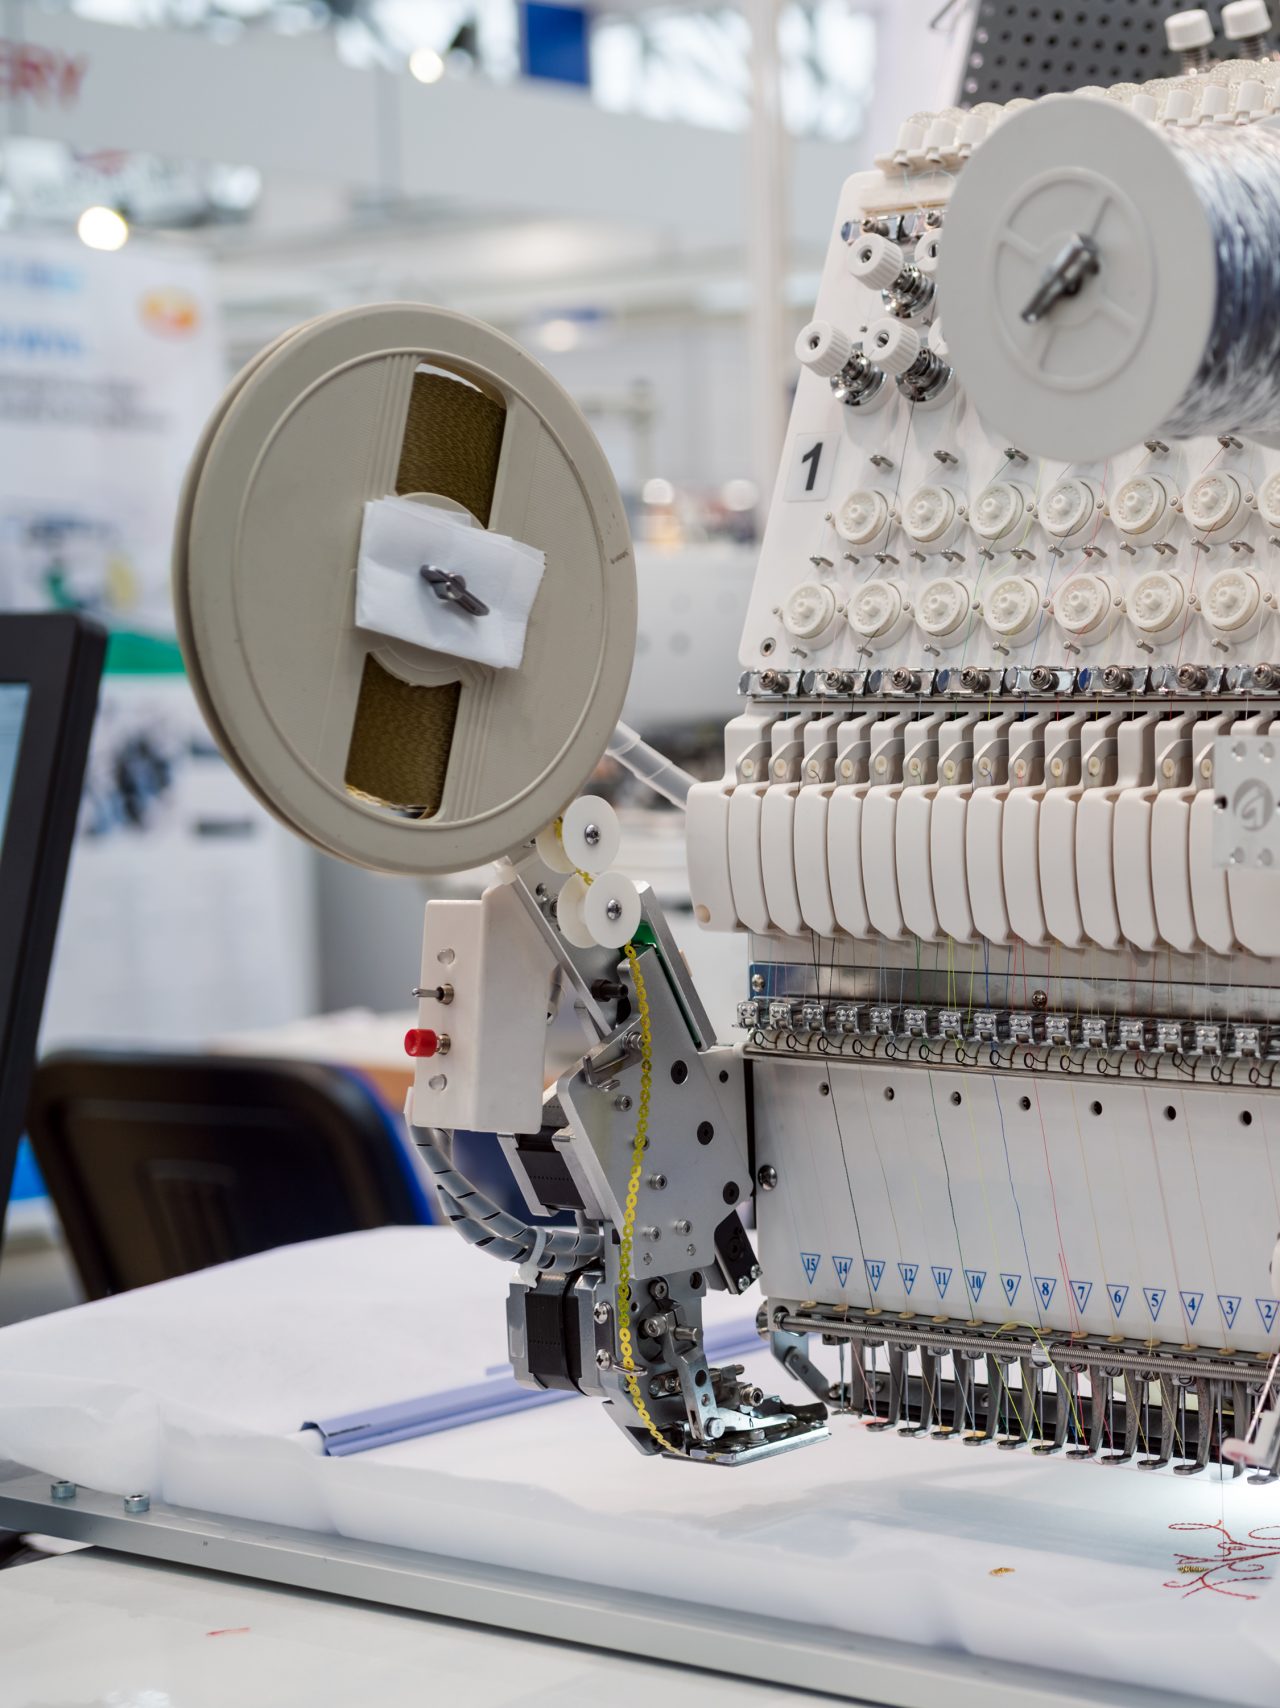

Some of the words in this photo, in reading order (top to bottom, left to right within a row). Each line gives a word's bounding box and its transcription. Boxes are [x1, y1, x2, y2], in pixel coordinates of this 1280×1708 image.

[802, 442, 823, 491] 1
[806, 1258, 816, 1271] 15
[838, 1261, 848, 1274] 14
[871, 1265, 880, 1278] 13
[904, 1268, 913, 1281] 12
[937, 1272, 946, 1285] 11
[971, 1275, 982, 1289] 10
[1006, 1279, 1014, 1292] 9
[1041, 1282, 1050, 1296] 8
[1077, 1286, 1085, 1299] 7
[1114, 1289, 1122, 1303] 6
[1151, 1293, 1159, 1307] 5
[1188, 1296, 1196, 1311] 4
[1226, 1301, 1234, 1315] 3
[1264, 1304, 1272, 1318] 2
